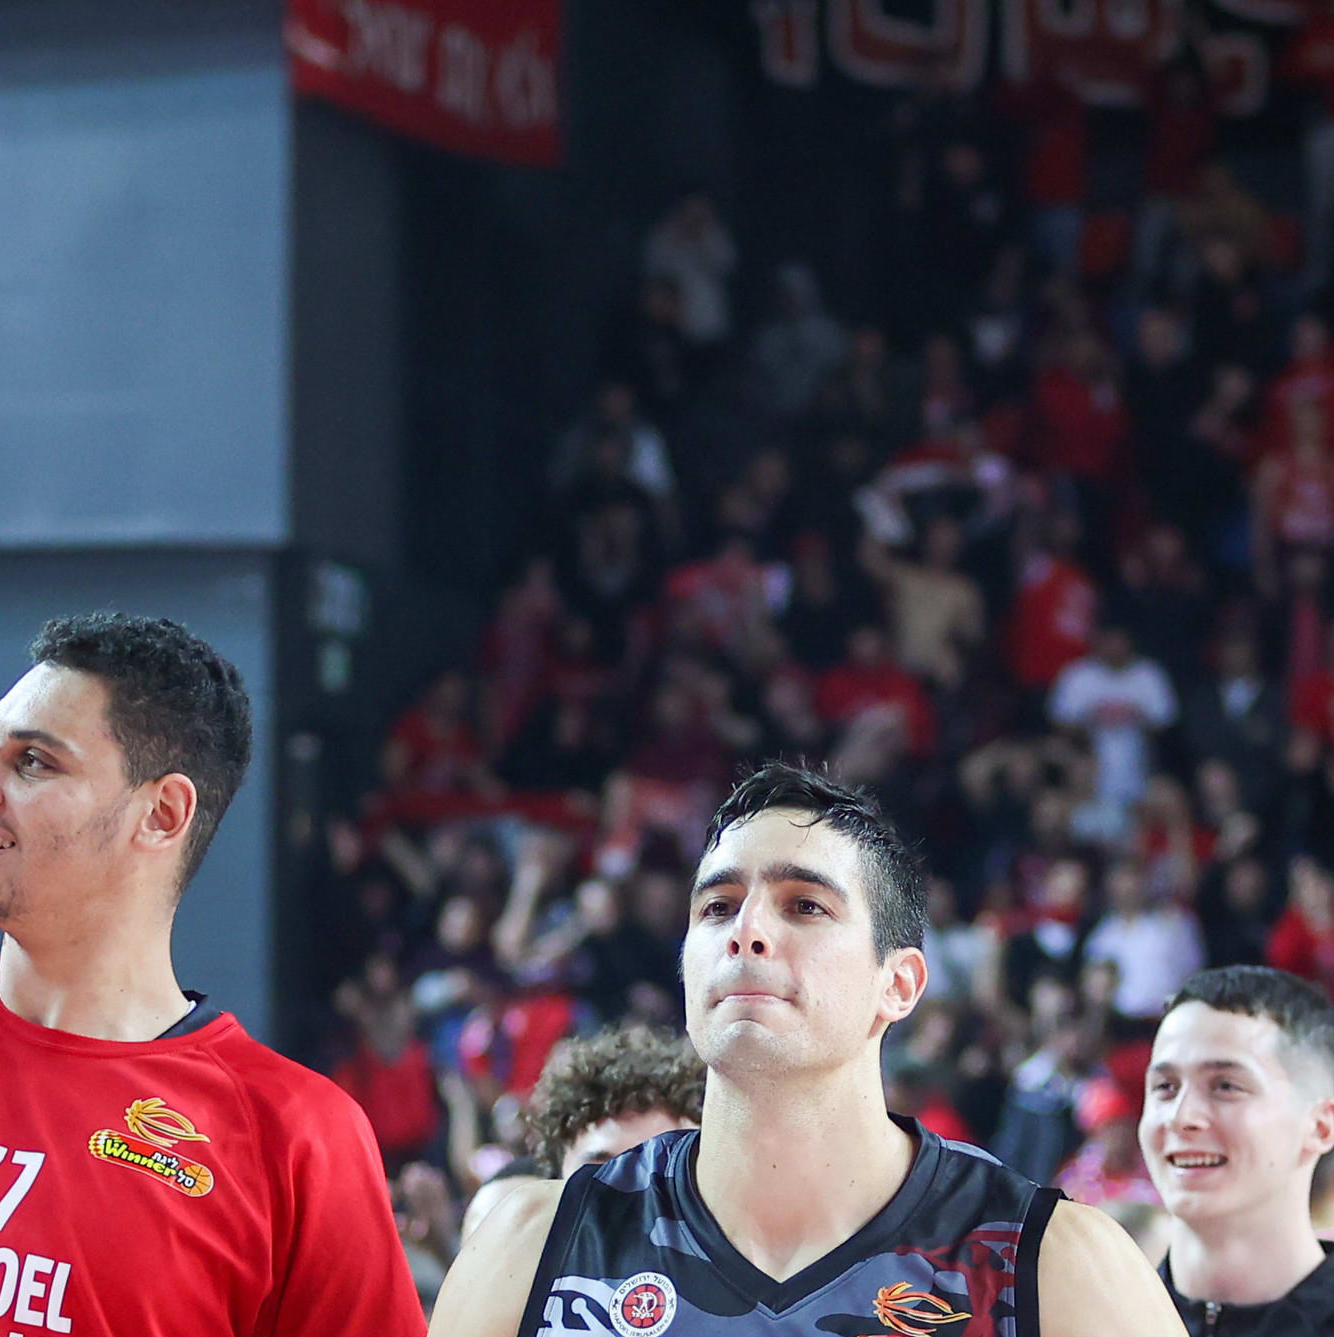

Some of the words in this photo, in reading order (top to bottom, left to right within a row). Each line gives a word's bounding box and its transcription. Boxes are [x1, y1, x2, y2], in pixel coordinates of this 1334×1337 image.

[104, 1138, 178, 1177] Winner
[176, 1169, 195, 1188] סל
[151, 1151, 179, 1169] ליגת
